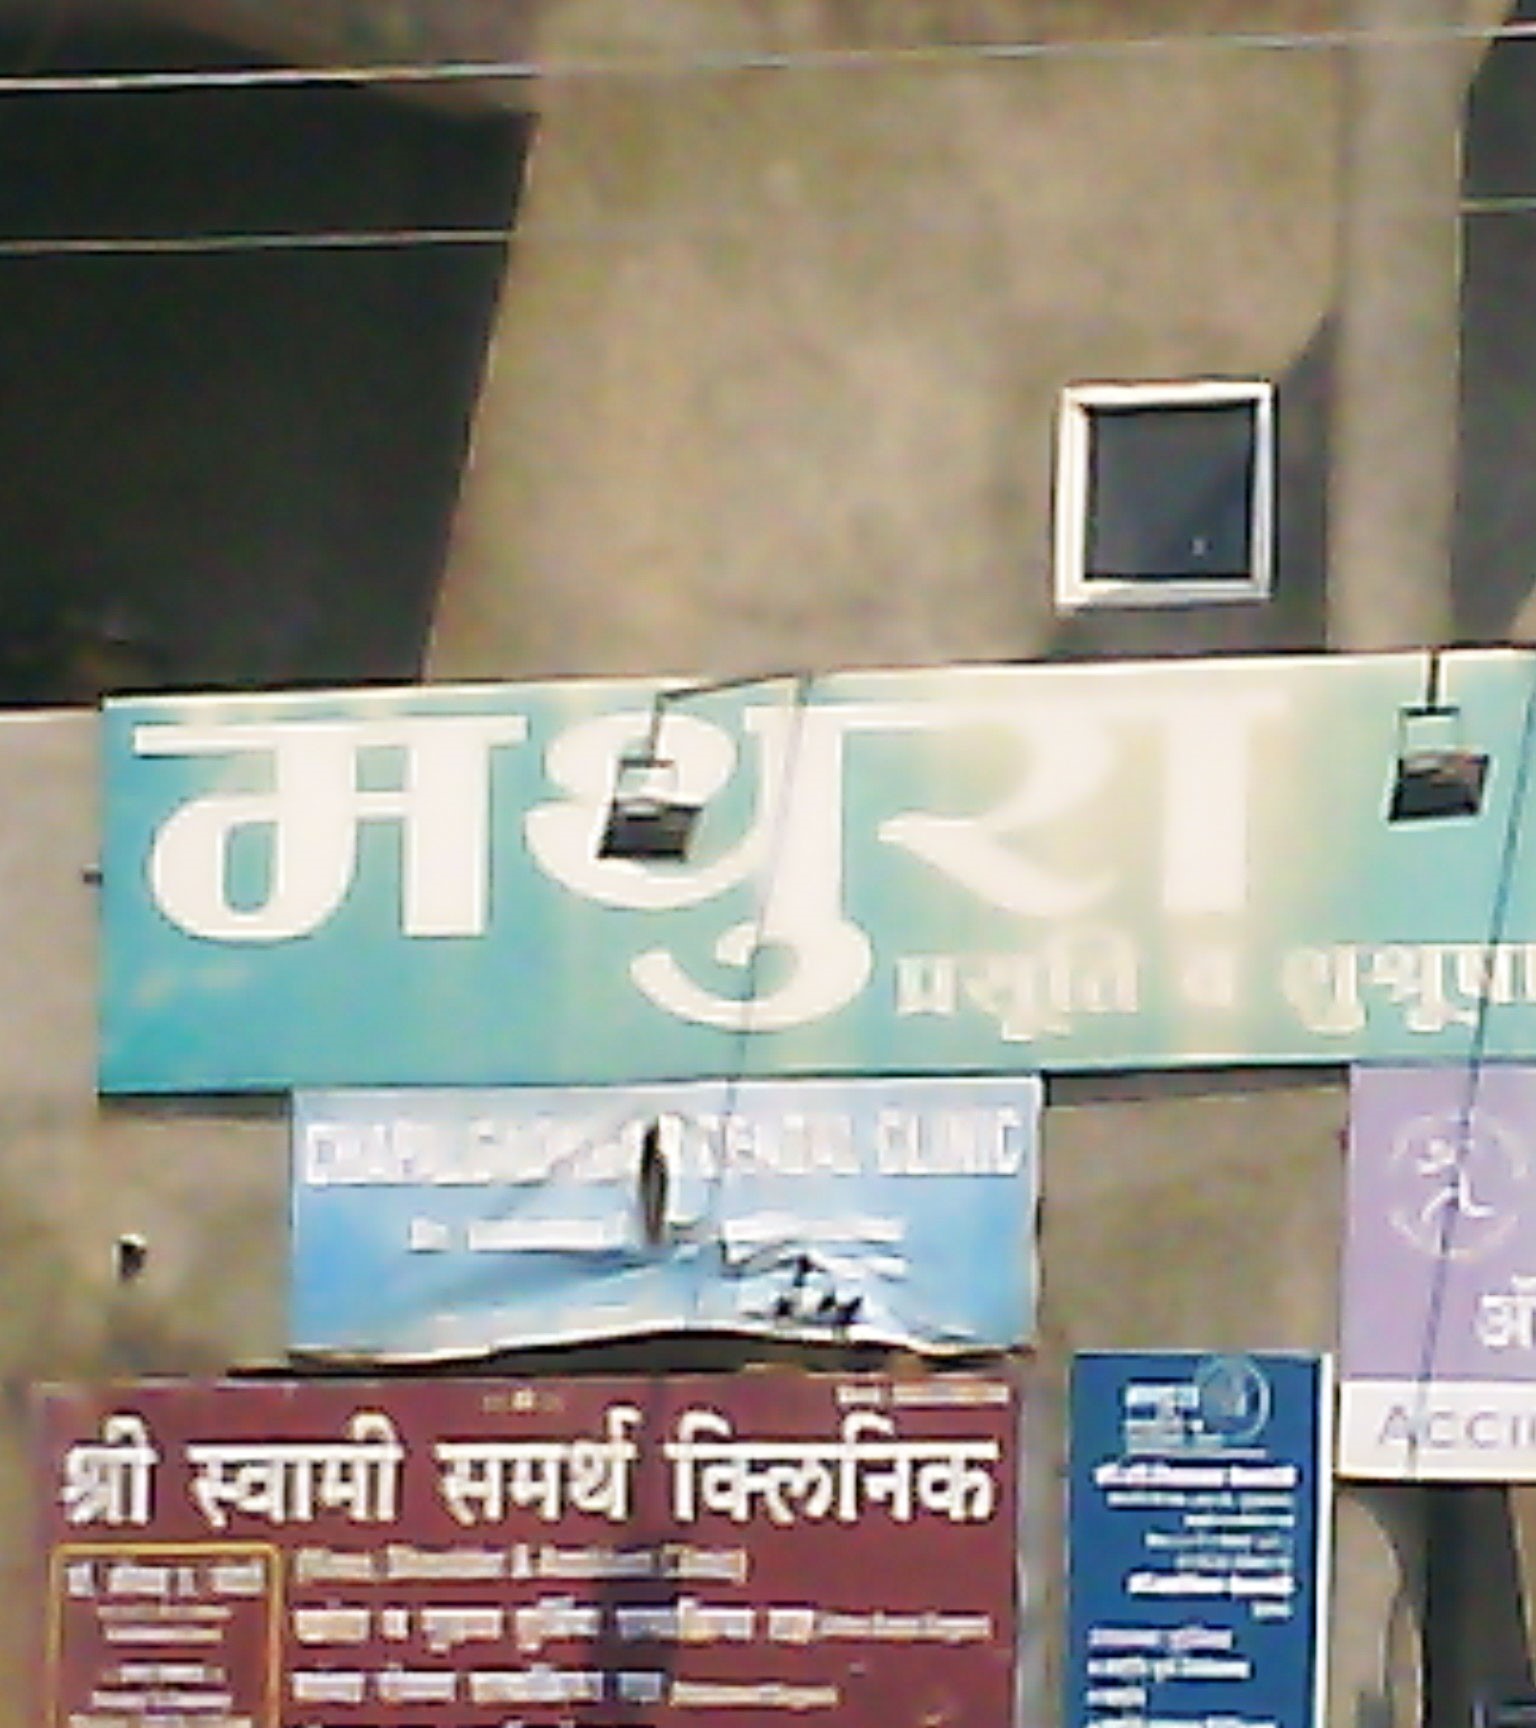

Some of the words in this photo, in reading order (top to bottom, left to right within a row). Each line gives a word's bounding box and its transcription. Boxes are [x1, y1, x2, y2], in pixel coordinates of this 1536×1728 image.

[133, 694, 1284, 1030] मथुरा
[62, 1412, 160, 1526] श्री
[186, 1410, 404, 1530] स्वामी
[434, 1404, 642, 1526] समर्थ
[664, 1408, 1002, 1524] क्लिनिक
